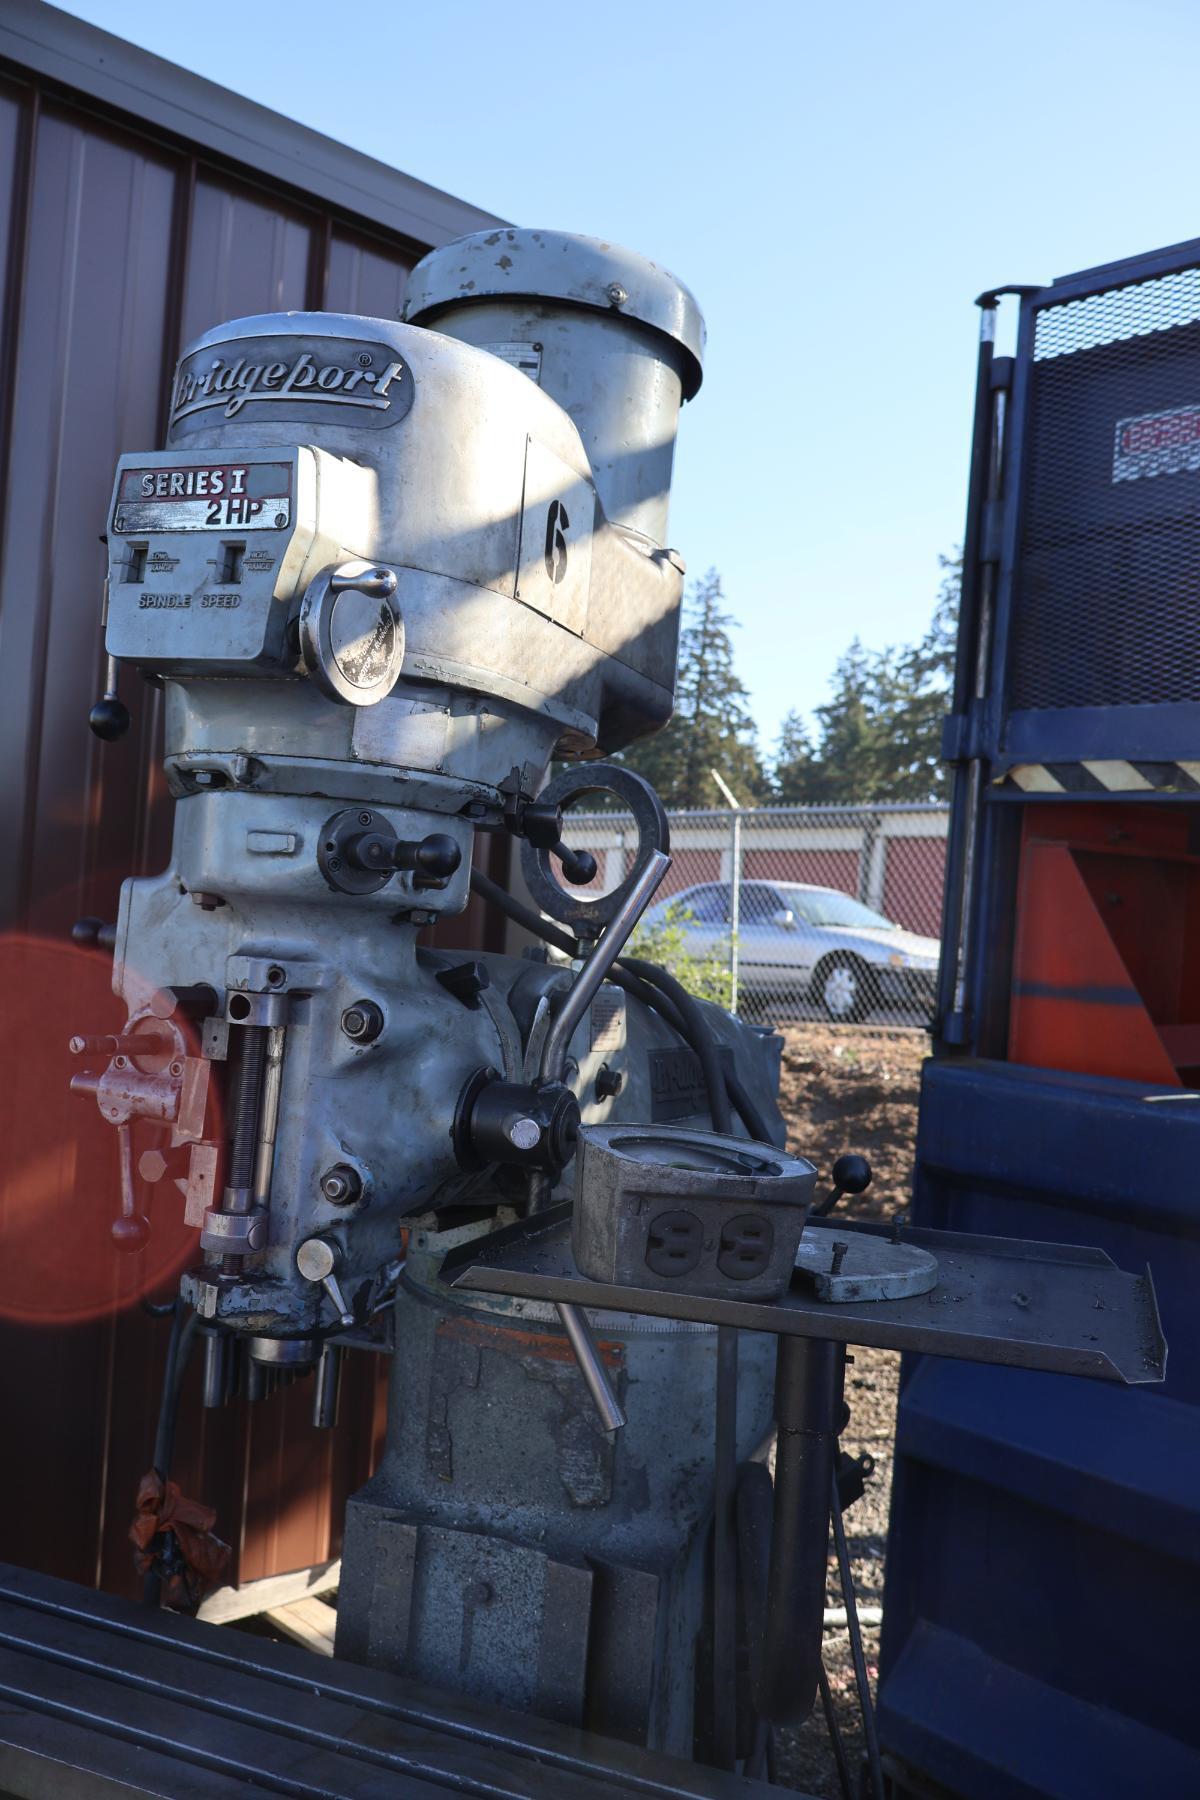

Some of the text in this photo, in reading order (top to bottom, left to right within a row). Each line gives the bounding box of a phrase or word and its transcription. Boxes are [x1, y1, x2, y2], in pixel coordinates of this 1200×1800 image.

[174, 354, 402, 418] Bridgeport
[141, 469, 246, 497] SERIES I
[544, 499, 570, 585] 6
[138, 594, 241, 609] SPINDLE SPEED
